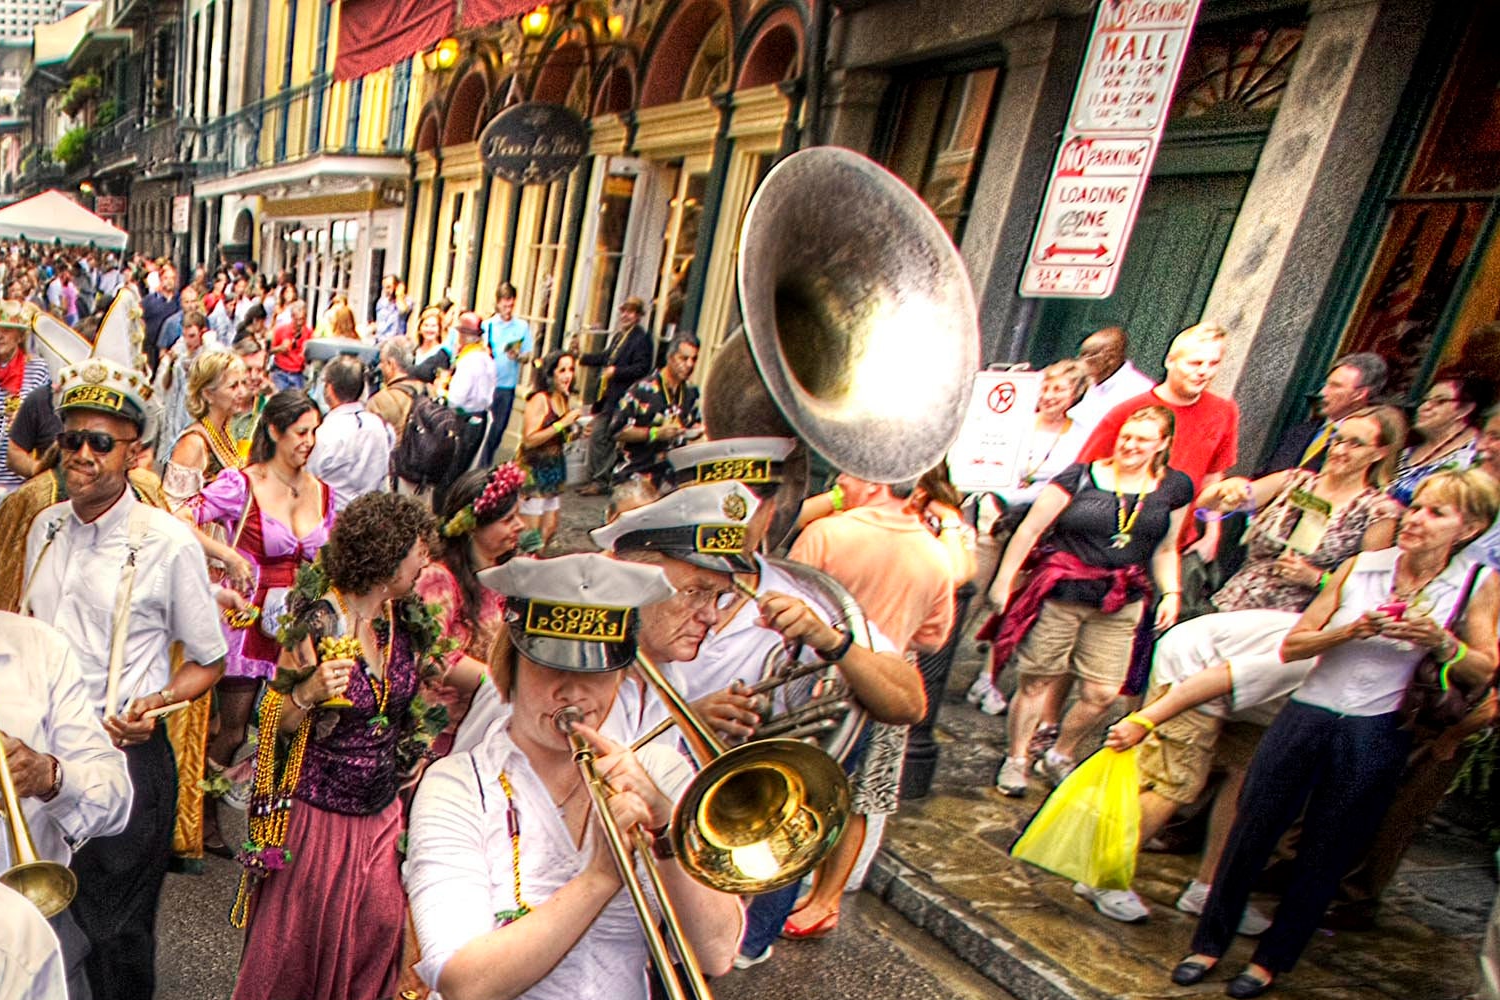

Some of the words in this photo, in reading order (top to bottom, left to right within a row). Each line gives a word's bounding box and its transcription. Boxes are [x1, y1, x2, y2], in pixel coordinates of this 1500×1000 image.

[1101, 0, 1127, 28] NO
[1127, 1, 1189, 24] PARKING
[1100, 33, 1168, 61] MALL
[1060, 143, 1086, 171] NO
[1086, 146, 1147, 166] PARKING
[1059, 186, 1128, 204] LOADING
[536, 616, 619, 636] POPPAS
[551, 606, 609, 623] CORK
